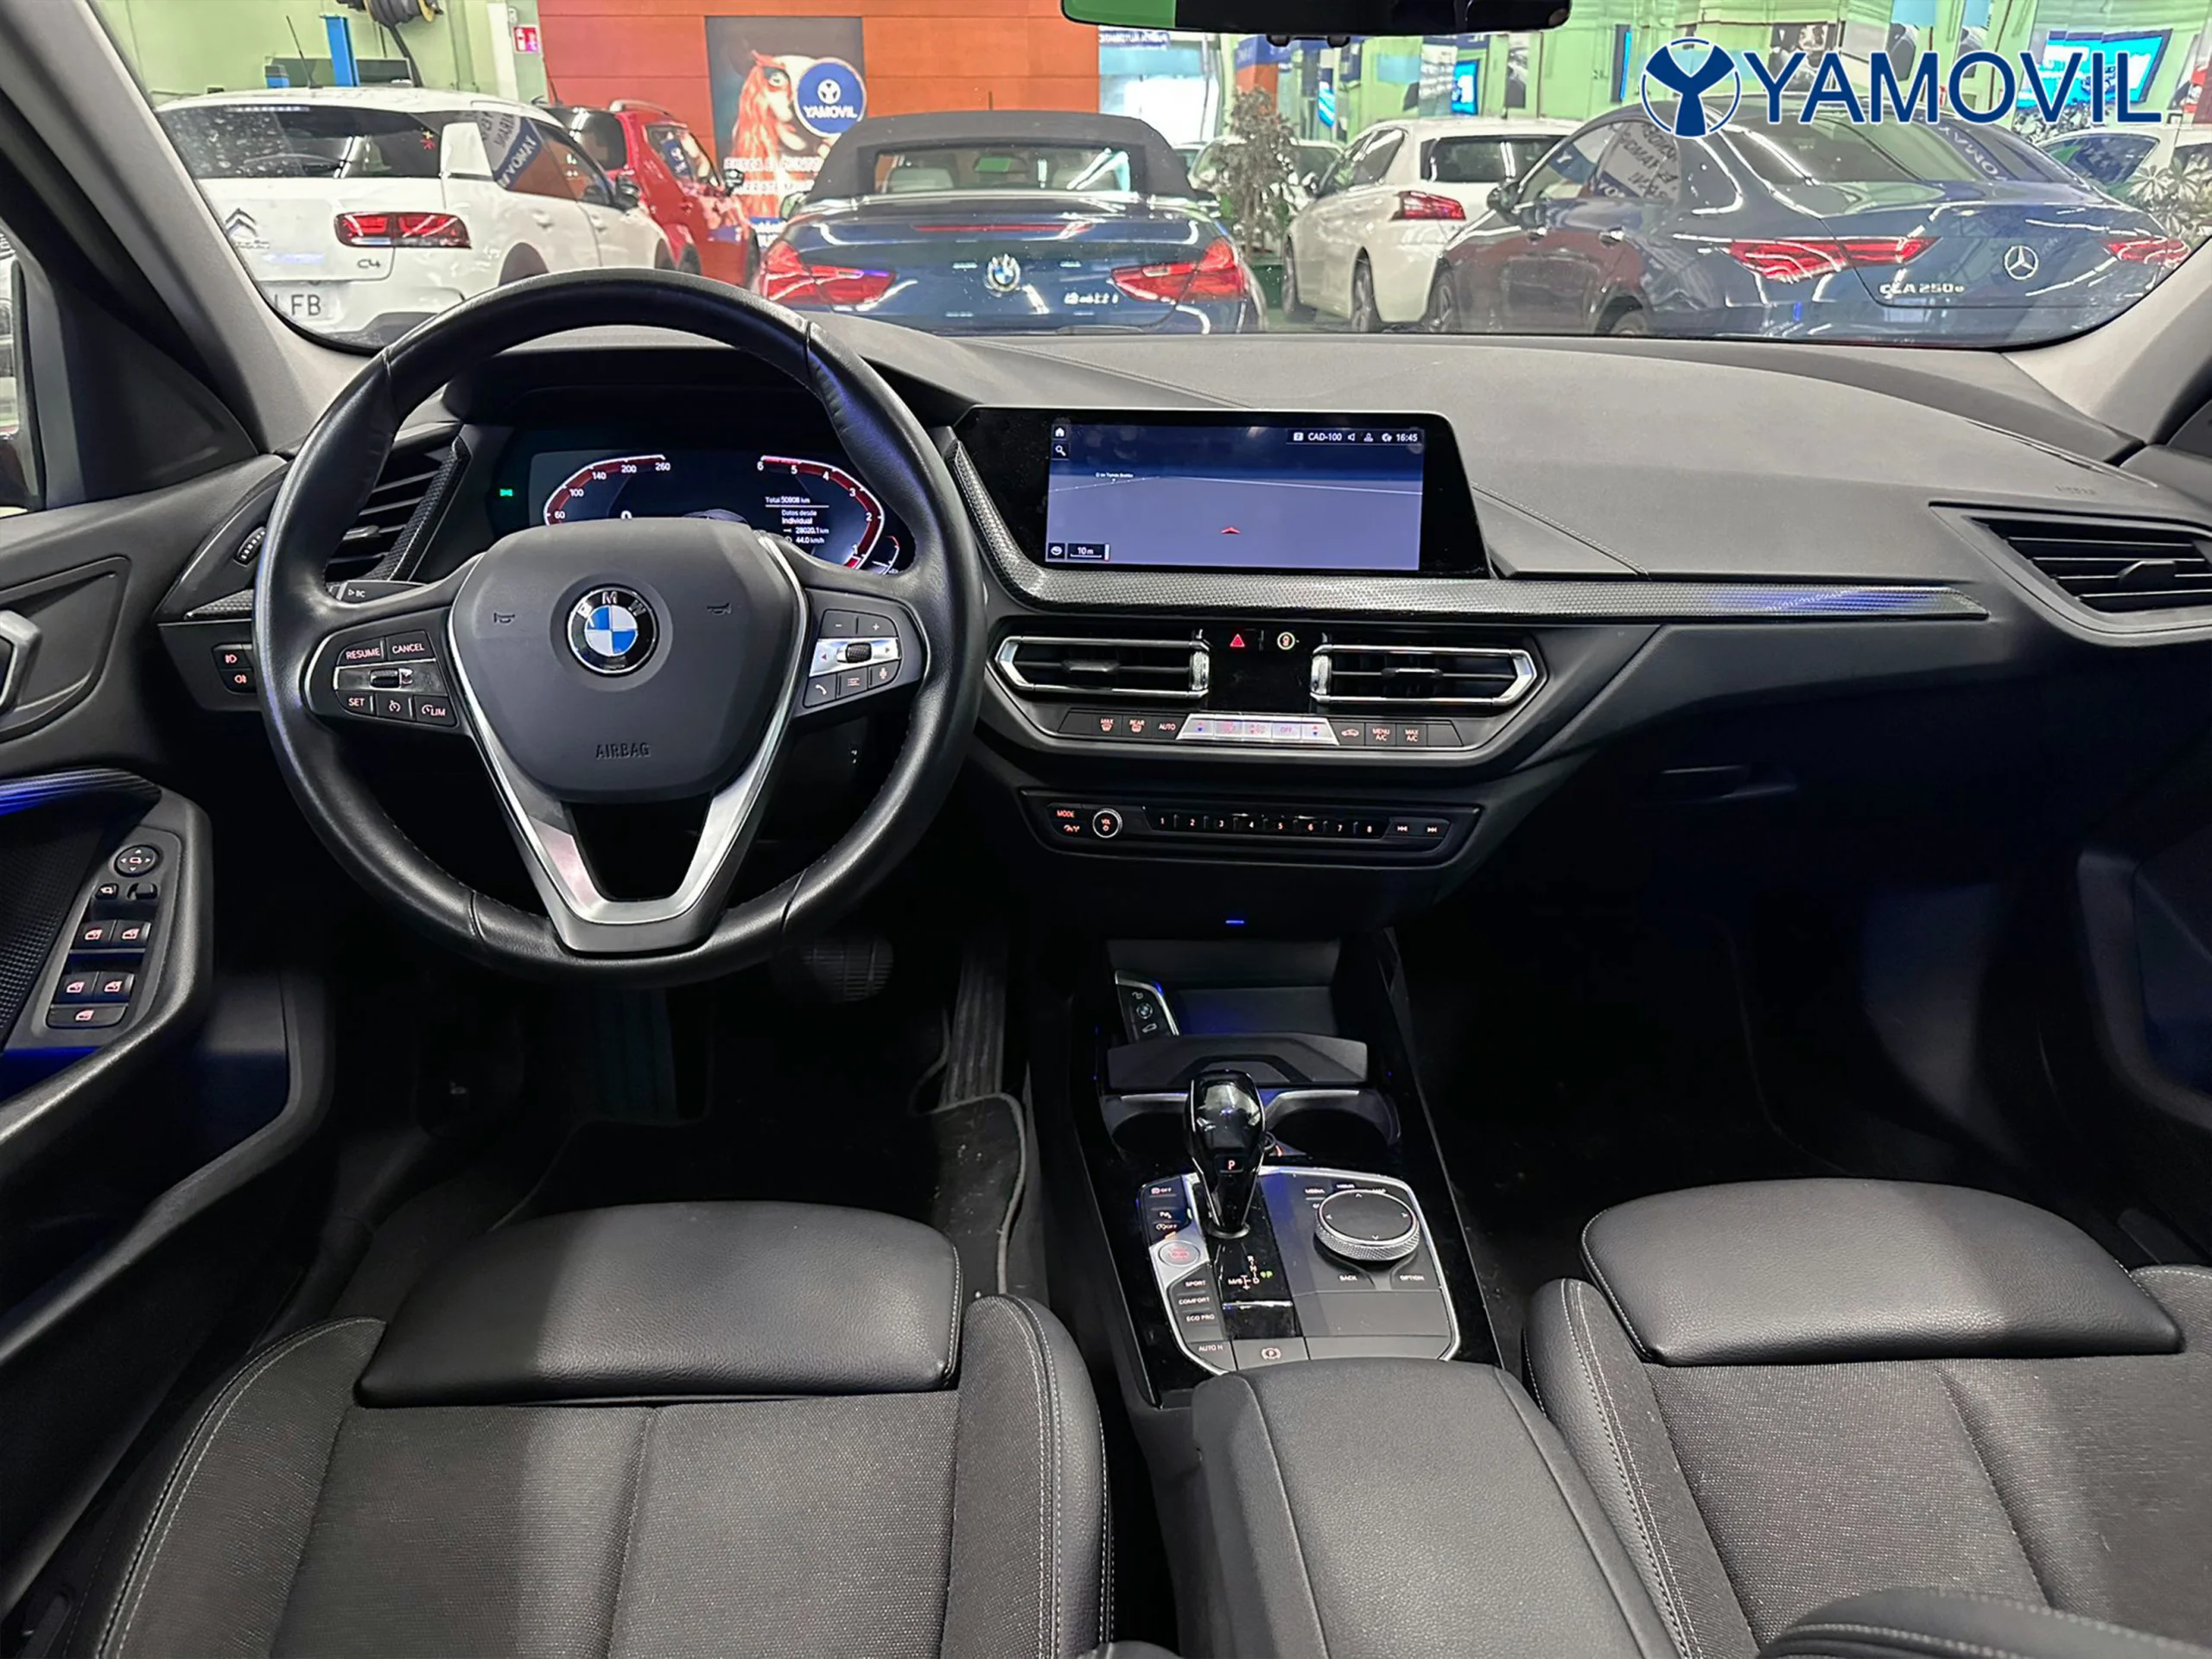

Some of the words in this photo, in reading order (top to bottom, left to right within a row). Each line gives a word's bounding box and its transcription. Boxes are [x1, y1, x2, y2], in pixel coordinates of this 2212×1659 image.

[803, 105, 858, 118] YAMOVIL
[357, 258, 381, 269] C4
[1307, 432, 1342, 442] CAD-100
[1395, 433, 1418, 442] 16:45
[621, 464, 638, 474] 200
[655, 461, 671, 471] 260
[757, 461, 764, 471] 6
[791, 465, 798, 474] 5
[592, 471, 607, 480] 140
[823, 471, 830, 480] 4
[569, 488, 584, 498] 100
[849, 487, 856, 497] 3
[554, 511, 566, 519] 60
[865, 512, 873, 521] 2
[851, 544, 858, 555] 1
[1077, 547, 1087, 556] 10
[391, 644, 425, 654] CANCEL
[346, 649, 381, 660] RESUME
[348, 697, 365, 707] SET
[430, 708, 446, 716] LIM
[595, 741, 651, 760] AIRBAG
[1057, 810, 1075, 818] MODE
[1227, 1159, 1236, 1170] P
[1179, 1297, 1210, 1306] COMFORT
